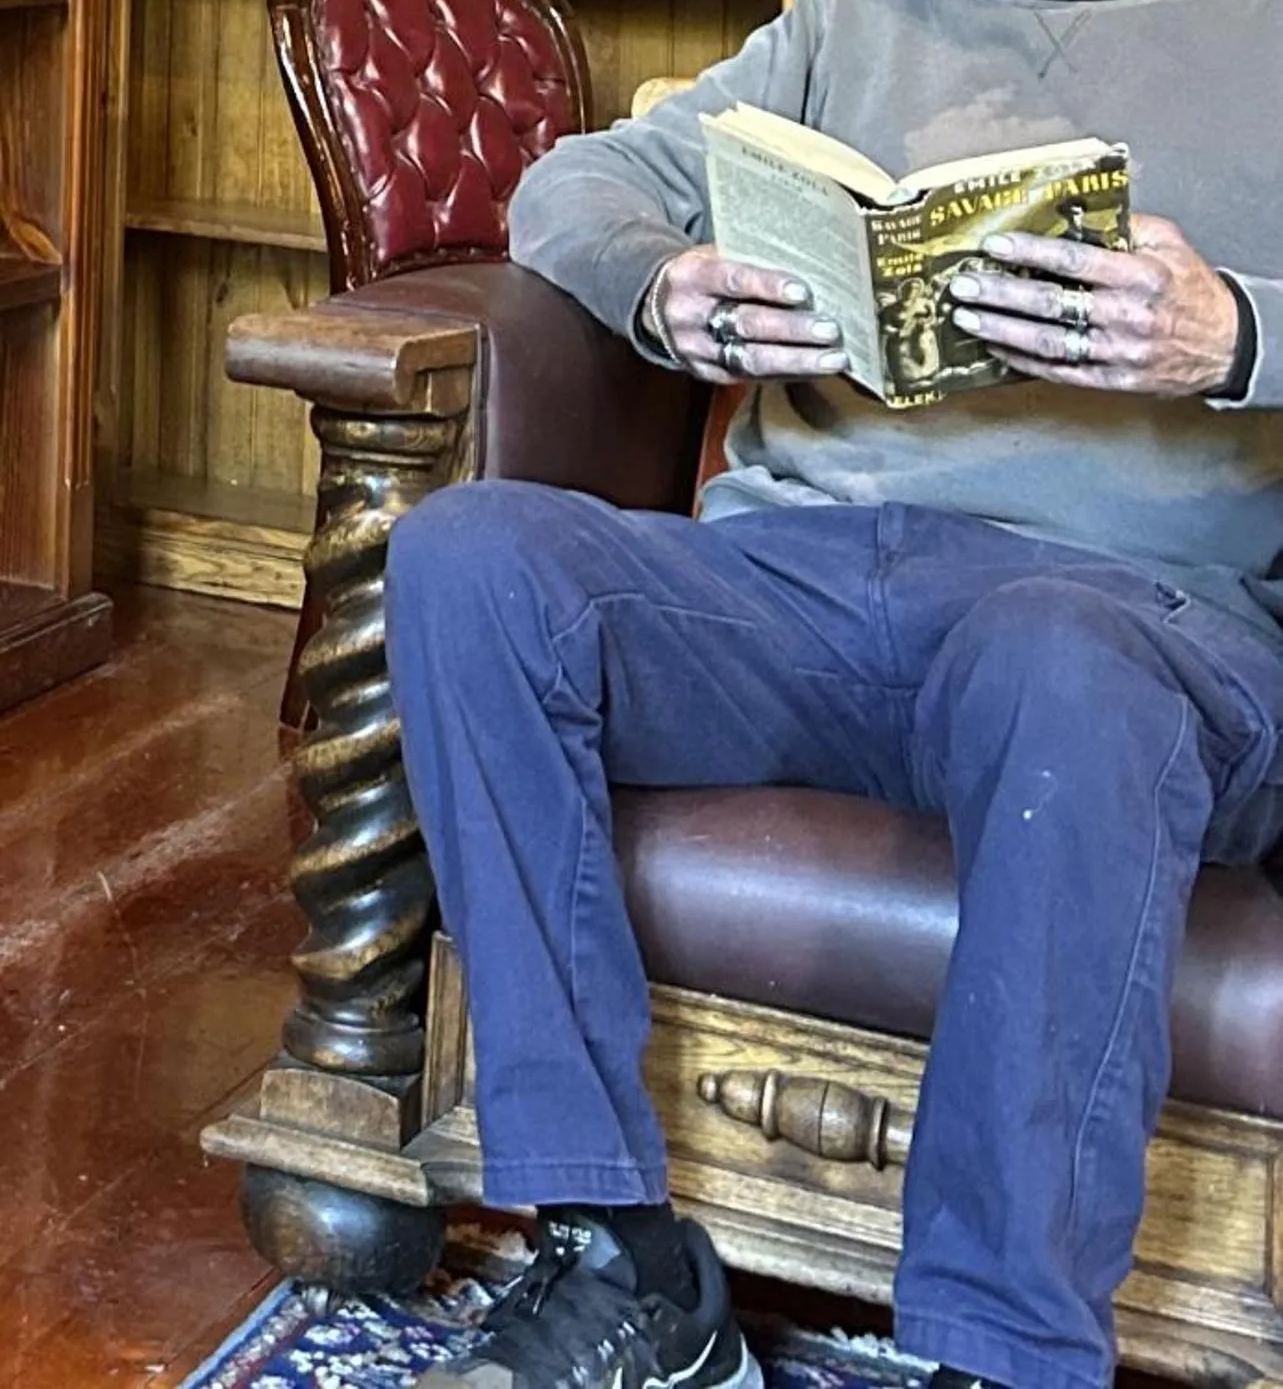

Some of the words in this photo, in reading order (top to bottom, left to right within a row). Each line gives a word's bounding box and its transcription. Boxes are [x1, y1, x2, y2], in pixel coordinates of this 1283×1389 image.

[930, 183, 1029, 227] SAVAGE
[1044, 169, 1128, 200] PARIS
[954, 169, 1022, 194] EMILE
